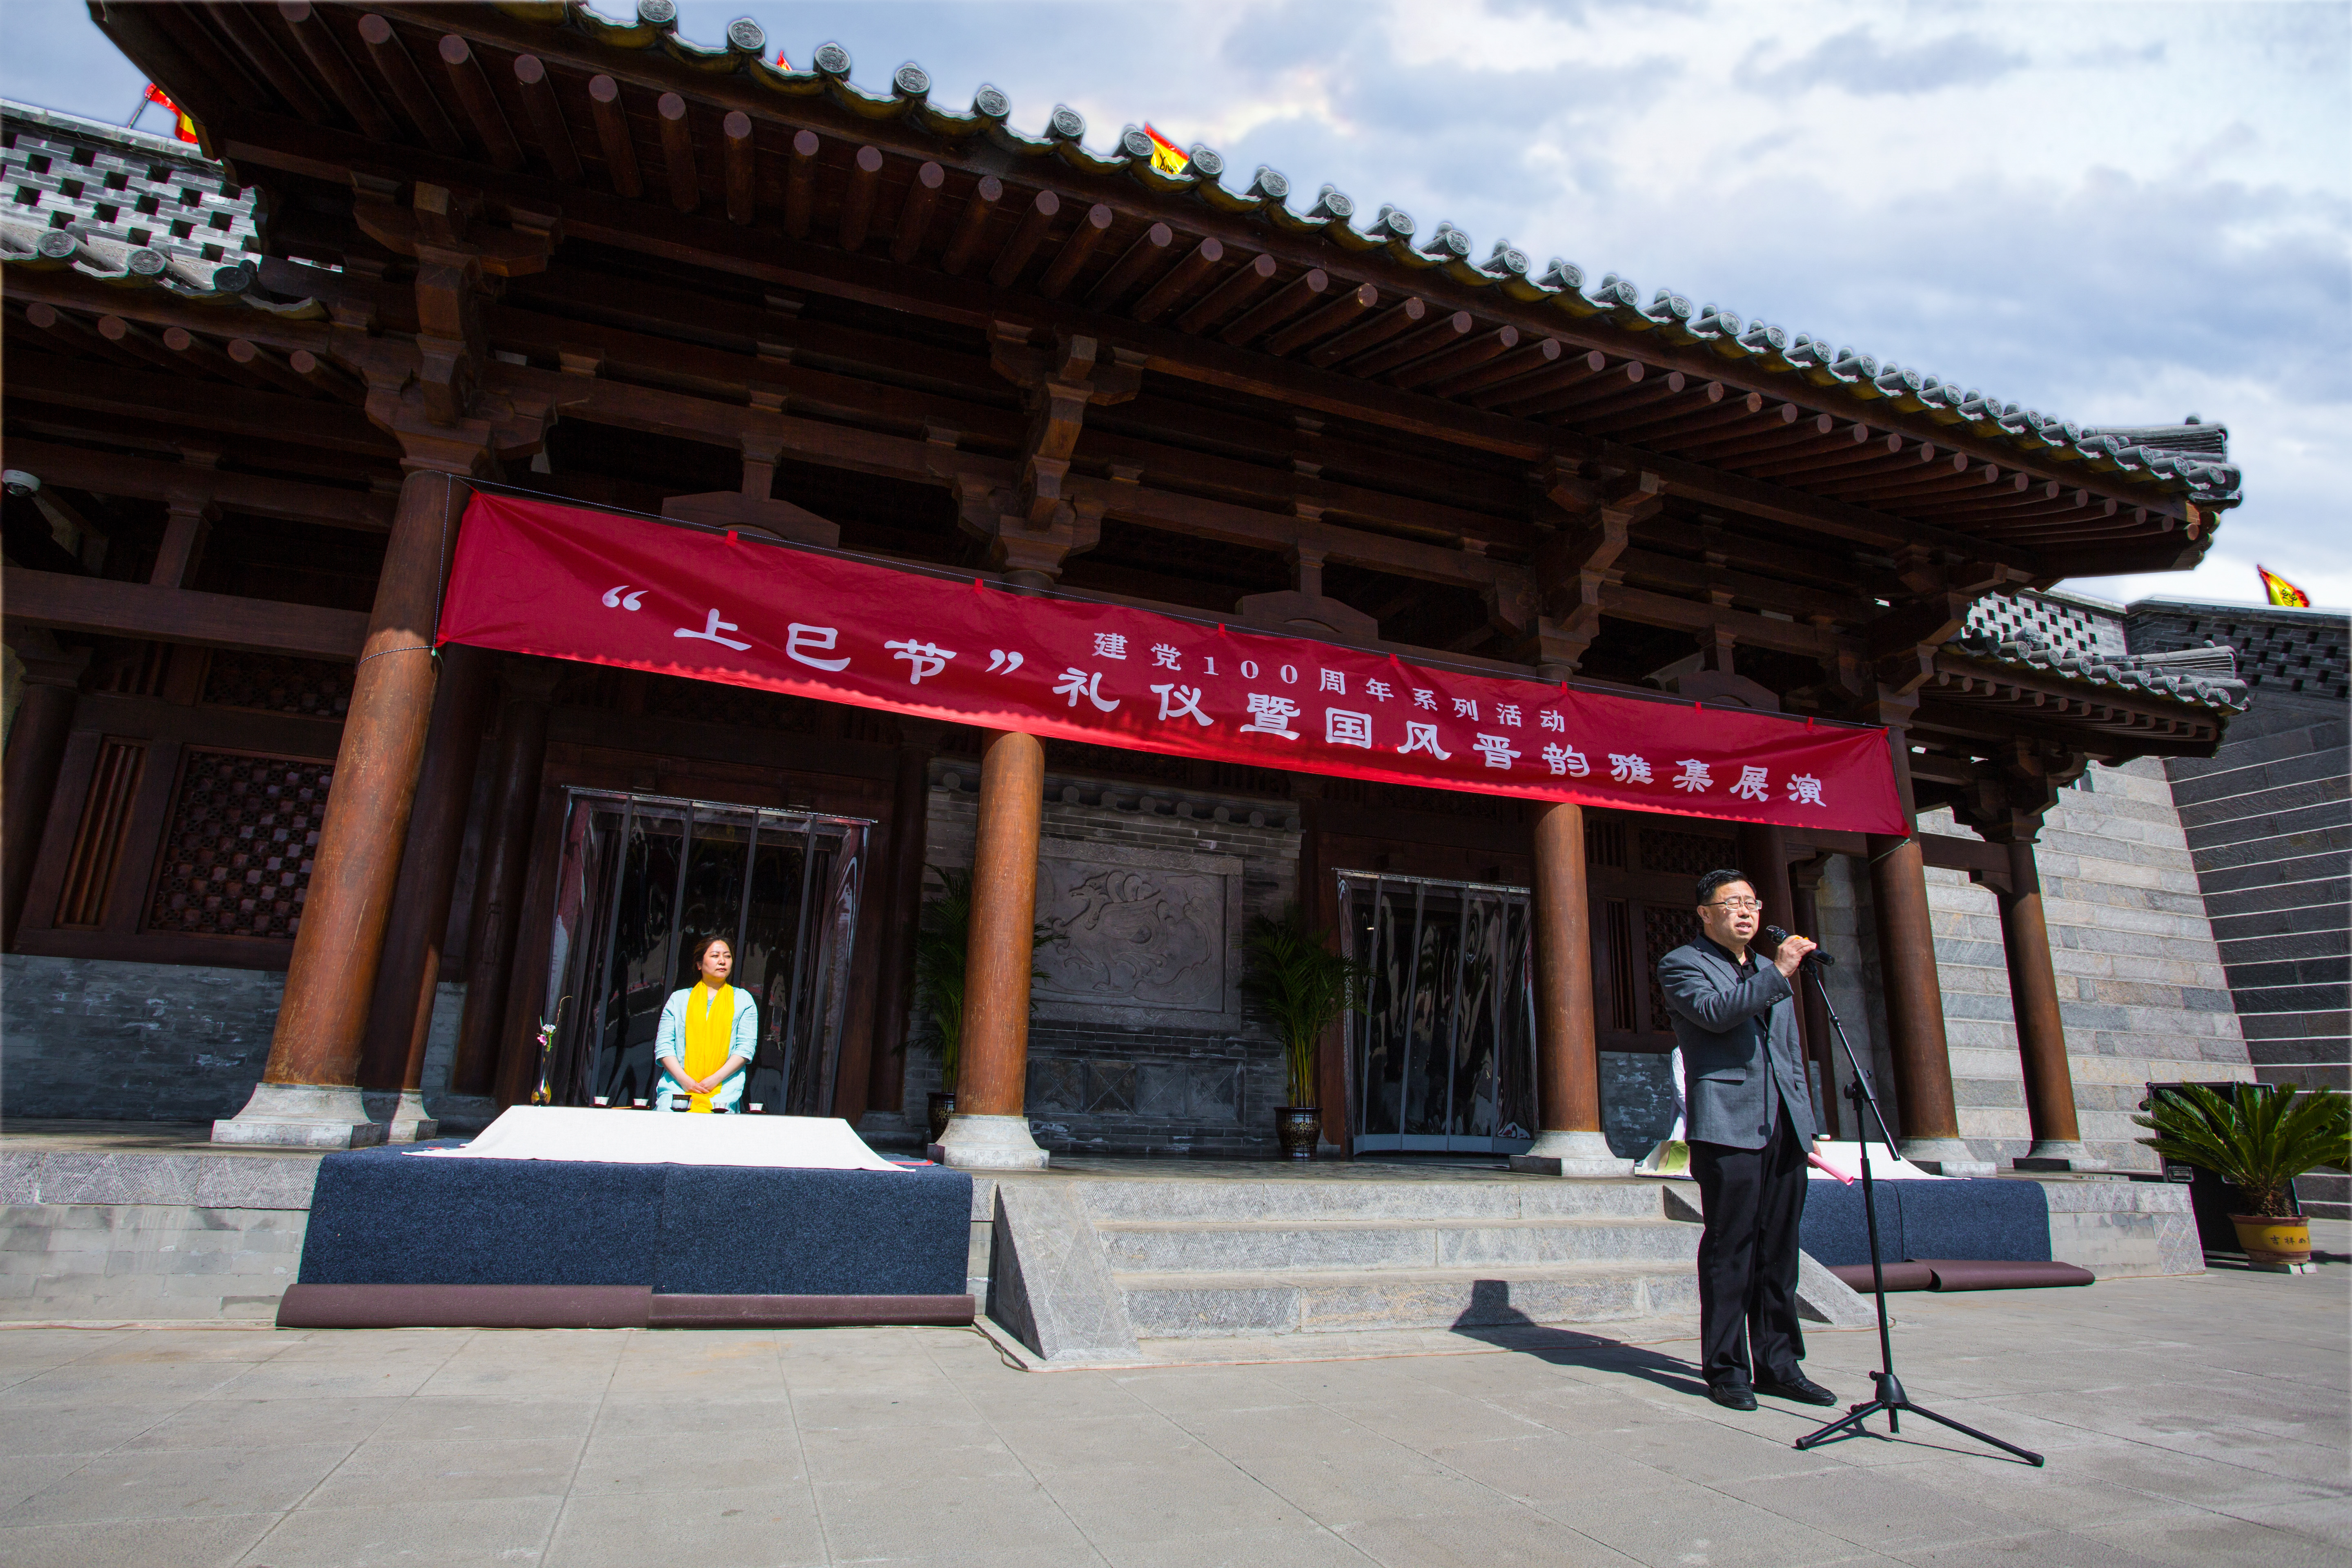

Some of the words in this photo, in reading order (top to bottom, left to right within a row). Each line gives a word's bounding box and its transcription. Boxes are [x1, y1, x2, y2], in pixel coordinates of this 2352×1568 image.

[1092, 633, 1565, 733] 建党100周年系列活动
[2269, 1234, 2310, 1245] 吉祥如
